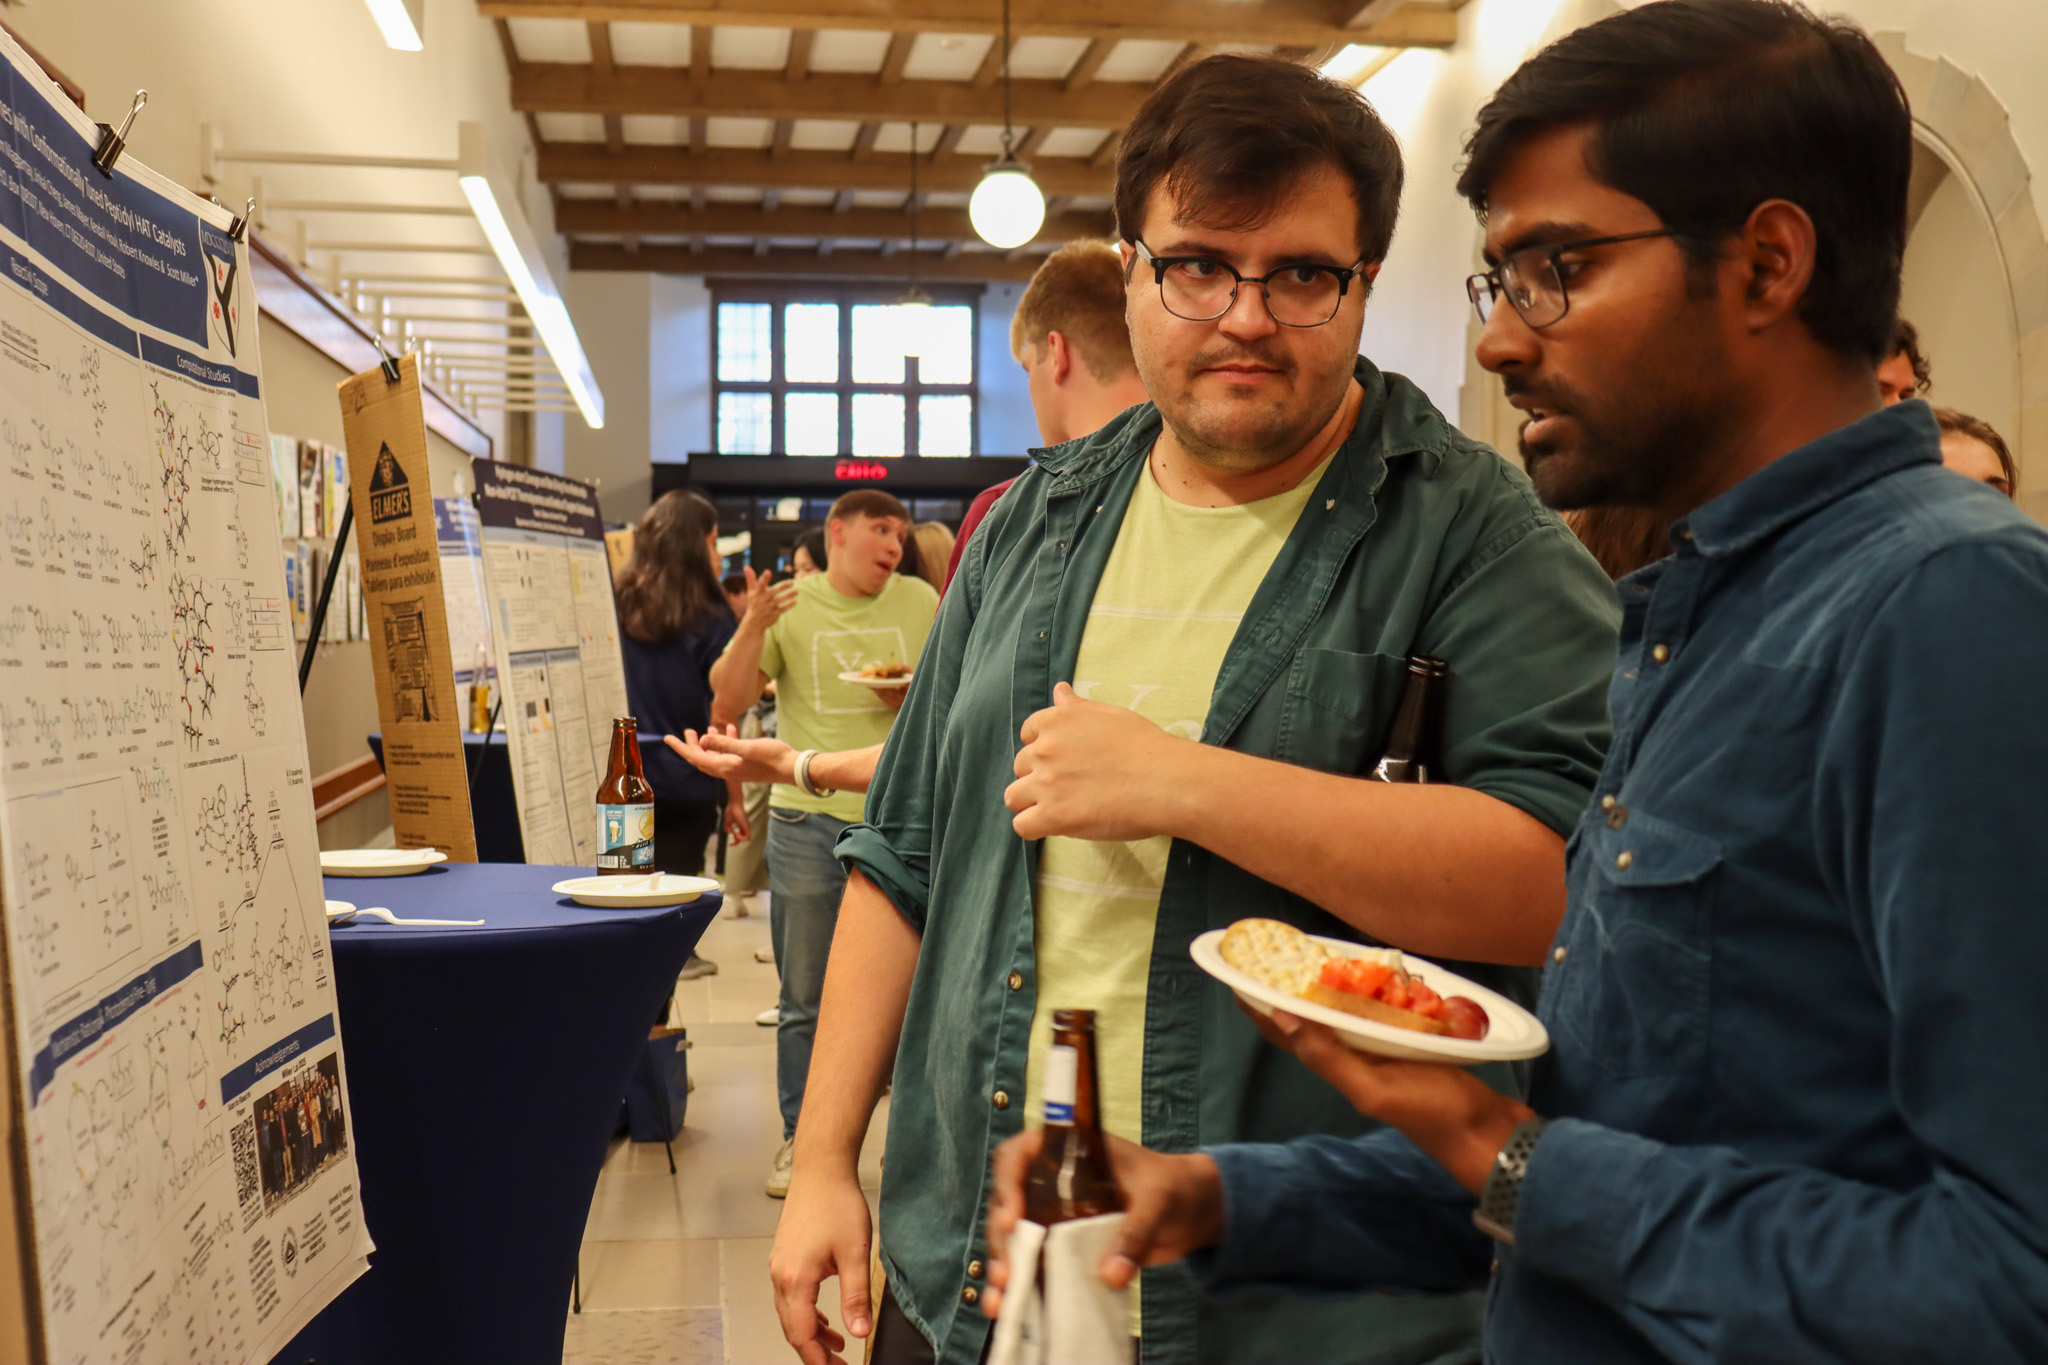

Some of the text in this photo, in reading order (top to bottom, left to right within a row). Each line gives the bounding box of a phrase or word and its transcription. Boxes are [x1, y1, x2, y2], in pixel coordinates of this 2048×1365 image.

[13, 112, 31, 143] with
[30, 124, 85, 198] Conformationally
[84, 175, 104, 210] Tuned
[103, 193, 135, 232] Peptidyl
[134, 213, 152, 239] HAT
[152, 224, 187, 257] Catalysts
[119, 238, 139, 260] Robert
[139, 248, 160, 273] Knowles
[160, 259, 166, 274] &
[167, 263, 180, 282] Scott
[177, 354, 206, 378] Computational
[206, 367, 231, 383] Studies
[373, 490, 410, 520] ELMER'S
[372, 522, 416, 548] Display Board
[365, 557, 392, 573] Panneau
[388, 576, 403, 592] para
[254, 1039, 300, 1075] Acknowledgements
